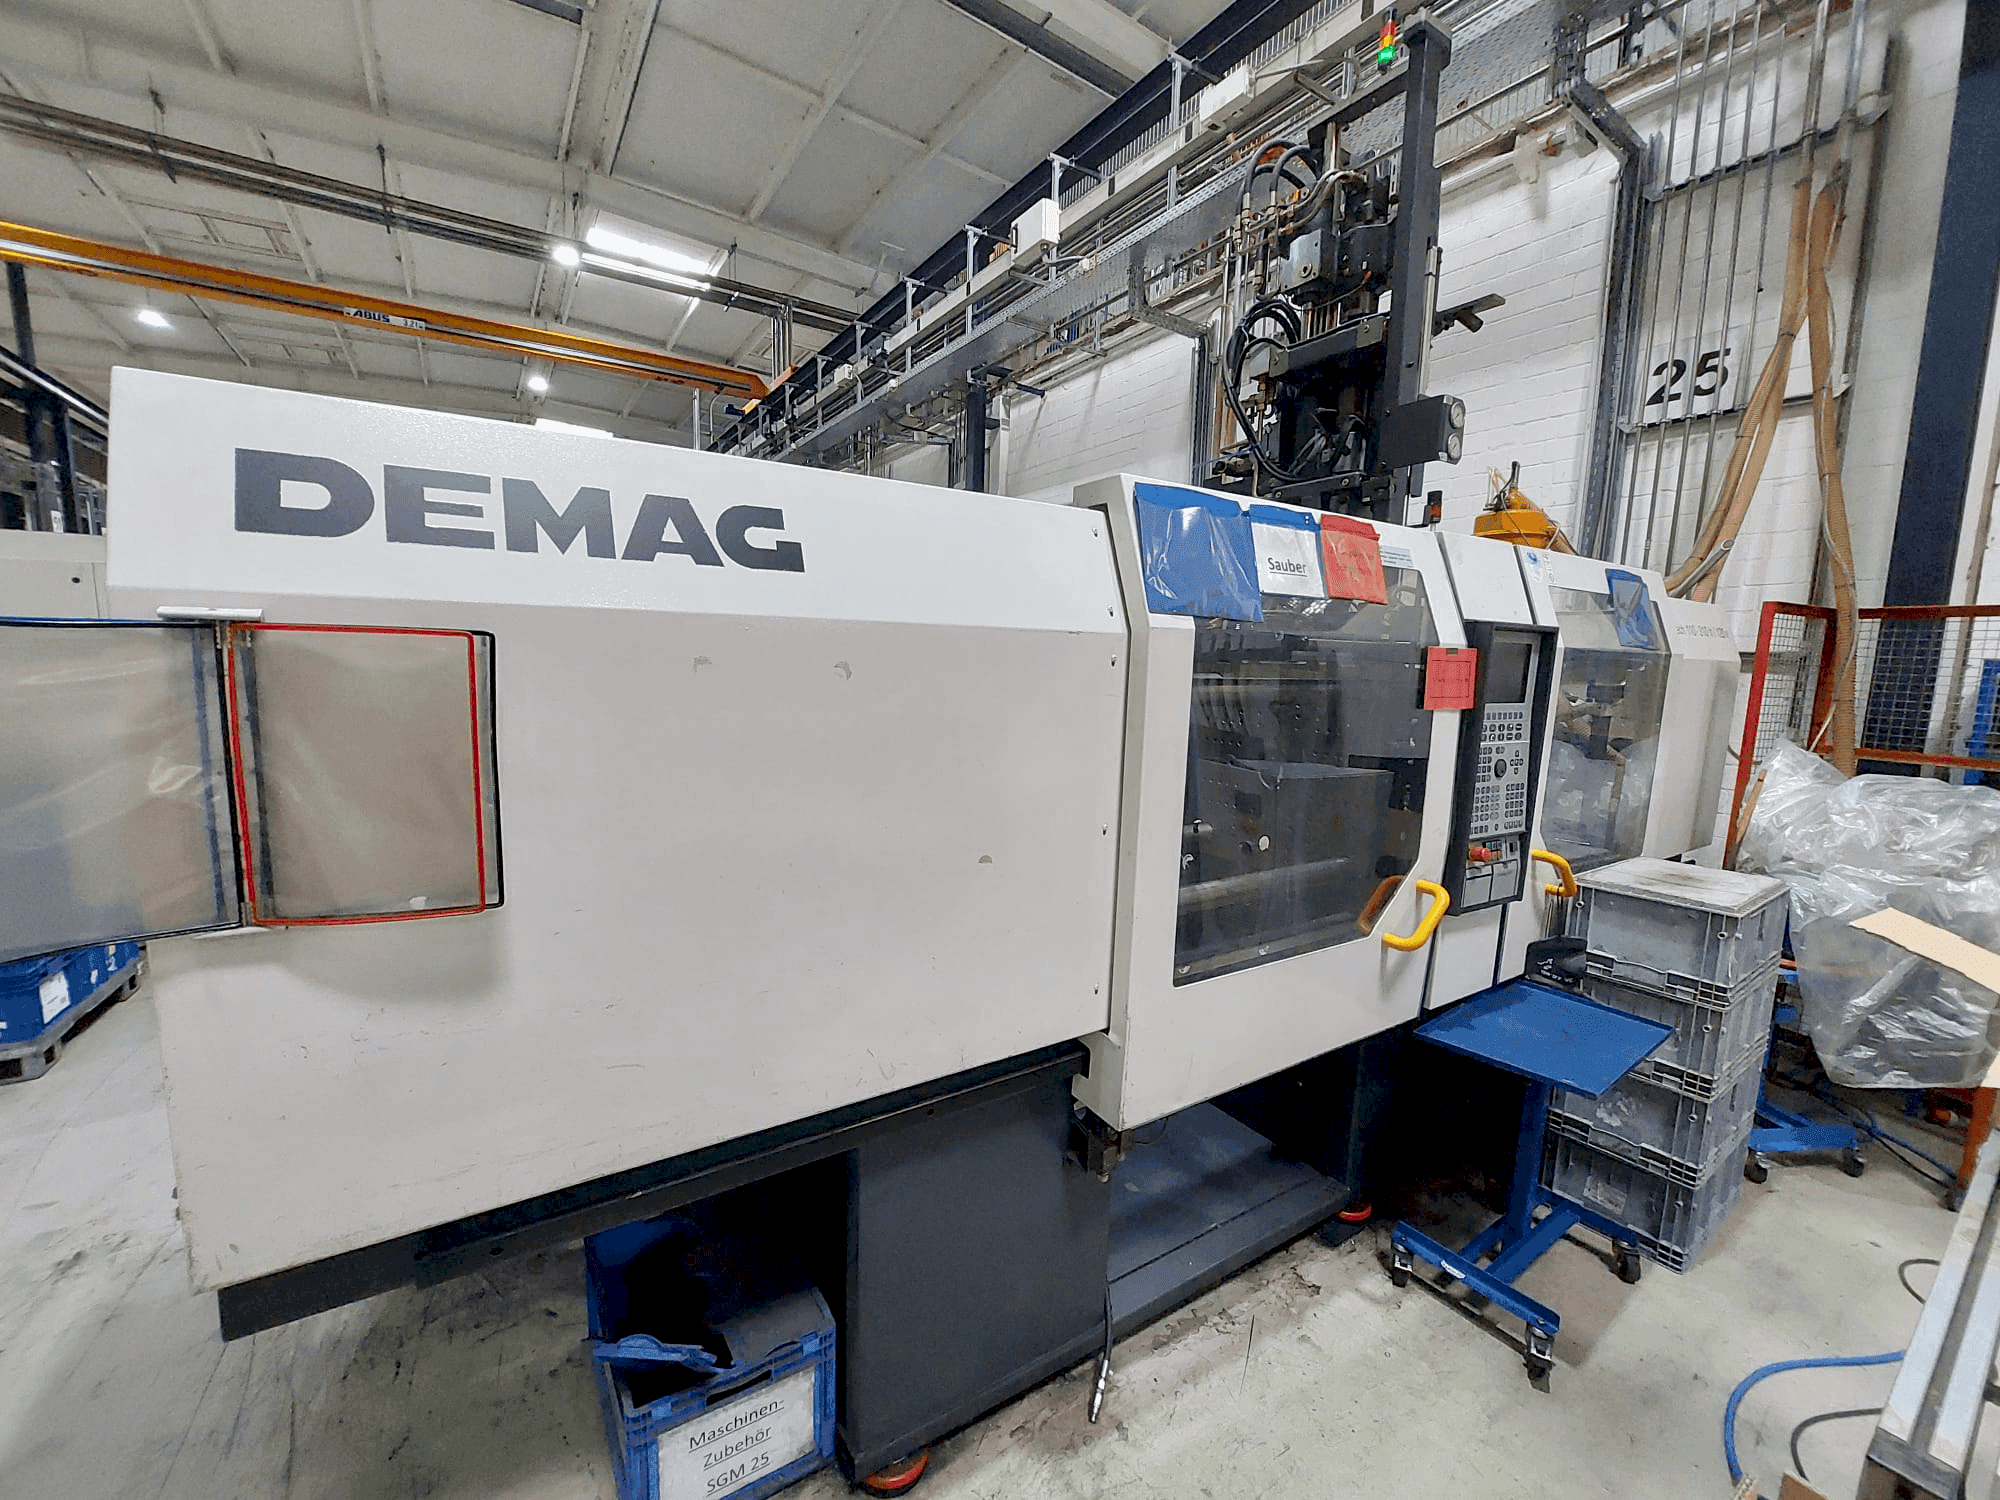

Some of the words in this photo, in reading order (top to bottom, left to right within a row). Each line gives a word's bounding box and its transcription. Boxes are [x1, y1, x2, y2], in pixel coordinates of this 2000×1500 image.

[353, 310, 390, 323] ABUS
[1645, 347, 1731, 406] 25
[235, 448, 805, 572] DEMAG
[1267, 557, 1307, 574] Sauber
[689, 1400, 785, 1450] Maschinen-
[703, 1427, 771, 1468] Zubehör
[706, 1463, 745, 1494] SGM
[751, 1451, 770, 1472] 25
